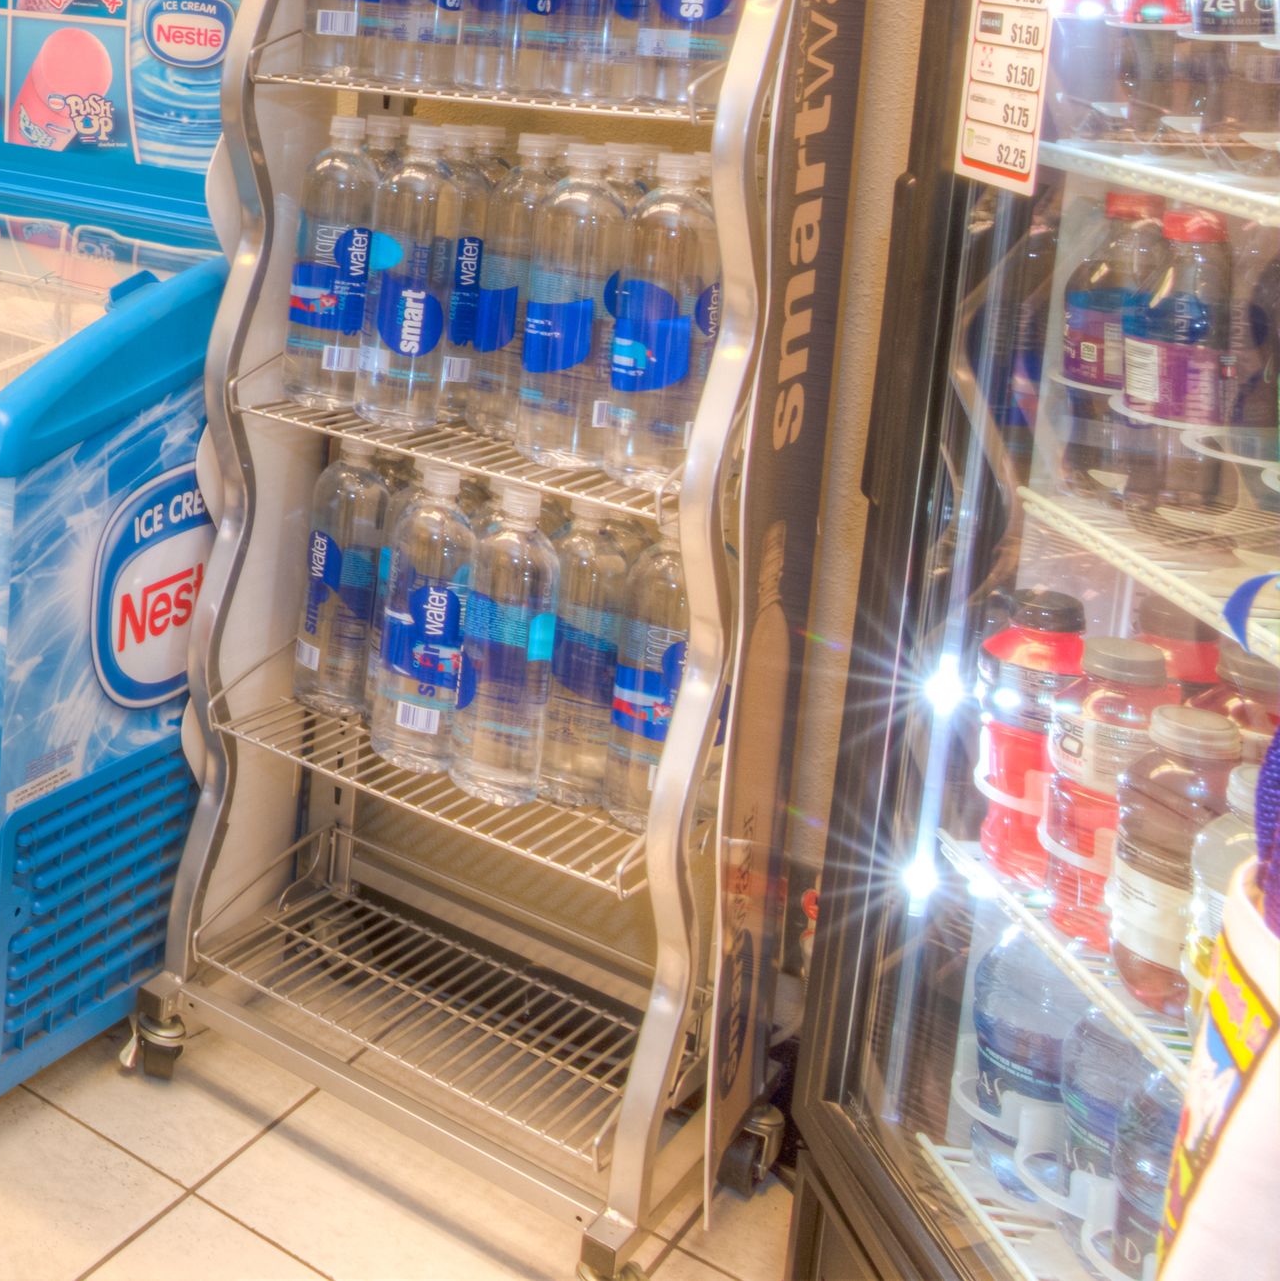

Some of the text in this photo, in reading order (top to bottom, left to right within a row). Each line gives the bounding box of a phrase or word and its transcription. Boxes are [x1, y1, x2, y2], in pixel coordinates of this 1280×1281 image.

[162, 0, 217, 15] ICE CREAM
[1010, 23, 1040, 47] $1.50
[1006, 63, 1035, 88] $1.50
[1002, 103, 1030, 128] $1.75
[997, 143, 1027, 170] $2.25
[347, 229, 369, 277] water
[457, 237, 480, 287] water
[134, 502, 164, 544] ICE
[311, 531, 328, 578] water
[424, 586, 448, 636] water
